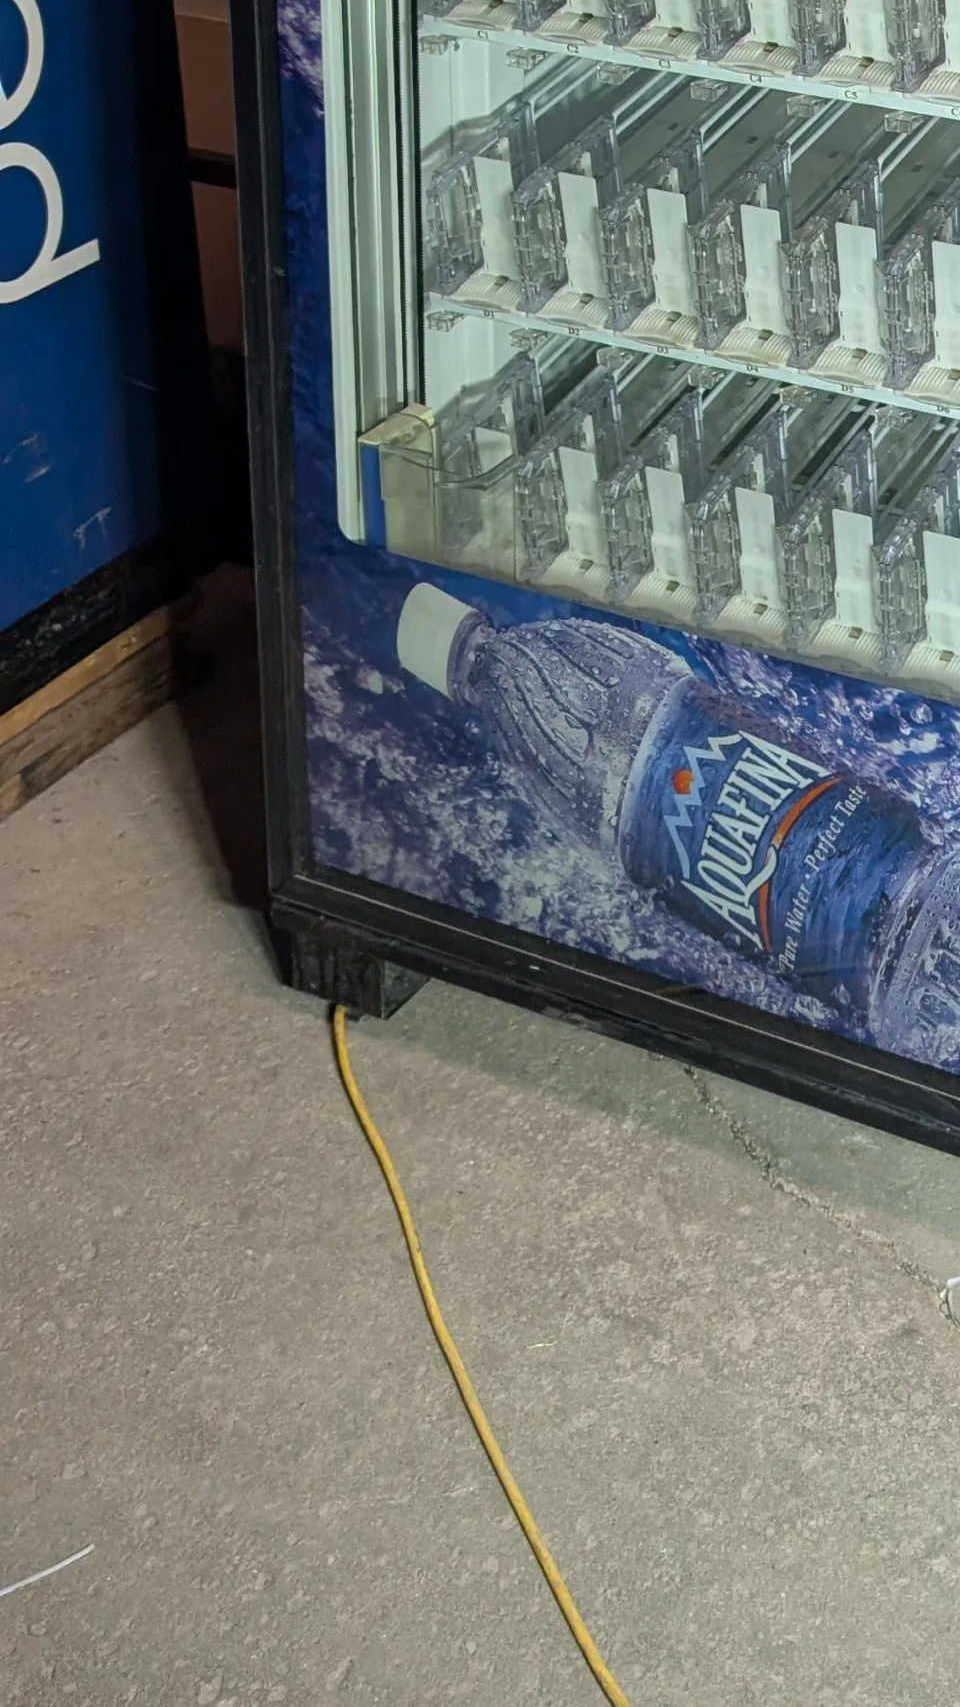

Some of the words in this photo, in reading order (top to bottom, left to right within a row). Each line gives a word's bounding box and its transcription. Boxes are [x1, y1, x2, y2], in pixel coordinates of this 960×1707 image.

[477, 29, 490, 40] C1
[566, 43, 580, 54] C2
[658, 58, 672, 69] C3
[749, 73, 763, 84] C4
[844, 89, 858, 100] C5
[567, 326, 581, 336] D2
[657, 344, 669, 354] D3
[746, 363, 759, 373] D4
[841, 384, 855, 393] D5
[936, 404, 950, 414] D6
[836, 783, 869, 819] Taste
[682, 730, 834, 950] AQUAFINA
[805, 816, 846, 878] Perfect
[785, 885, 810, 937] Water
[779, 932, 799, 971] Pure
